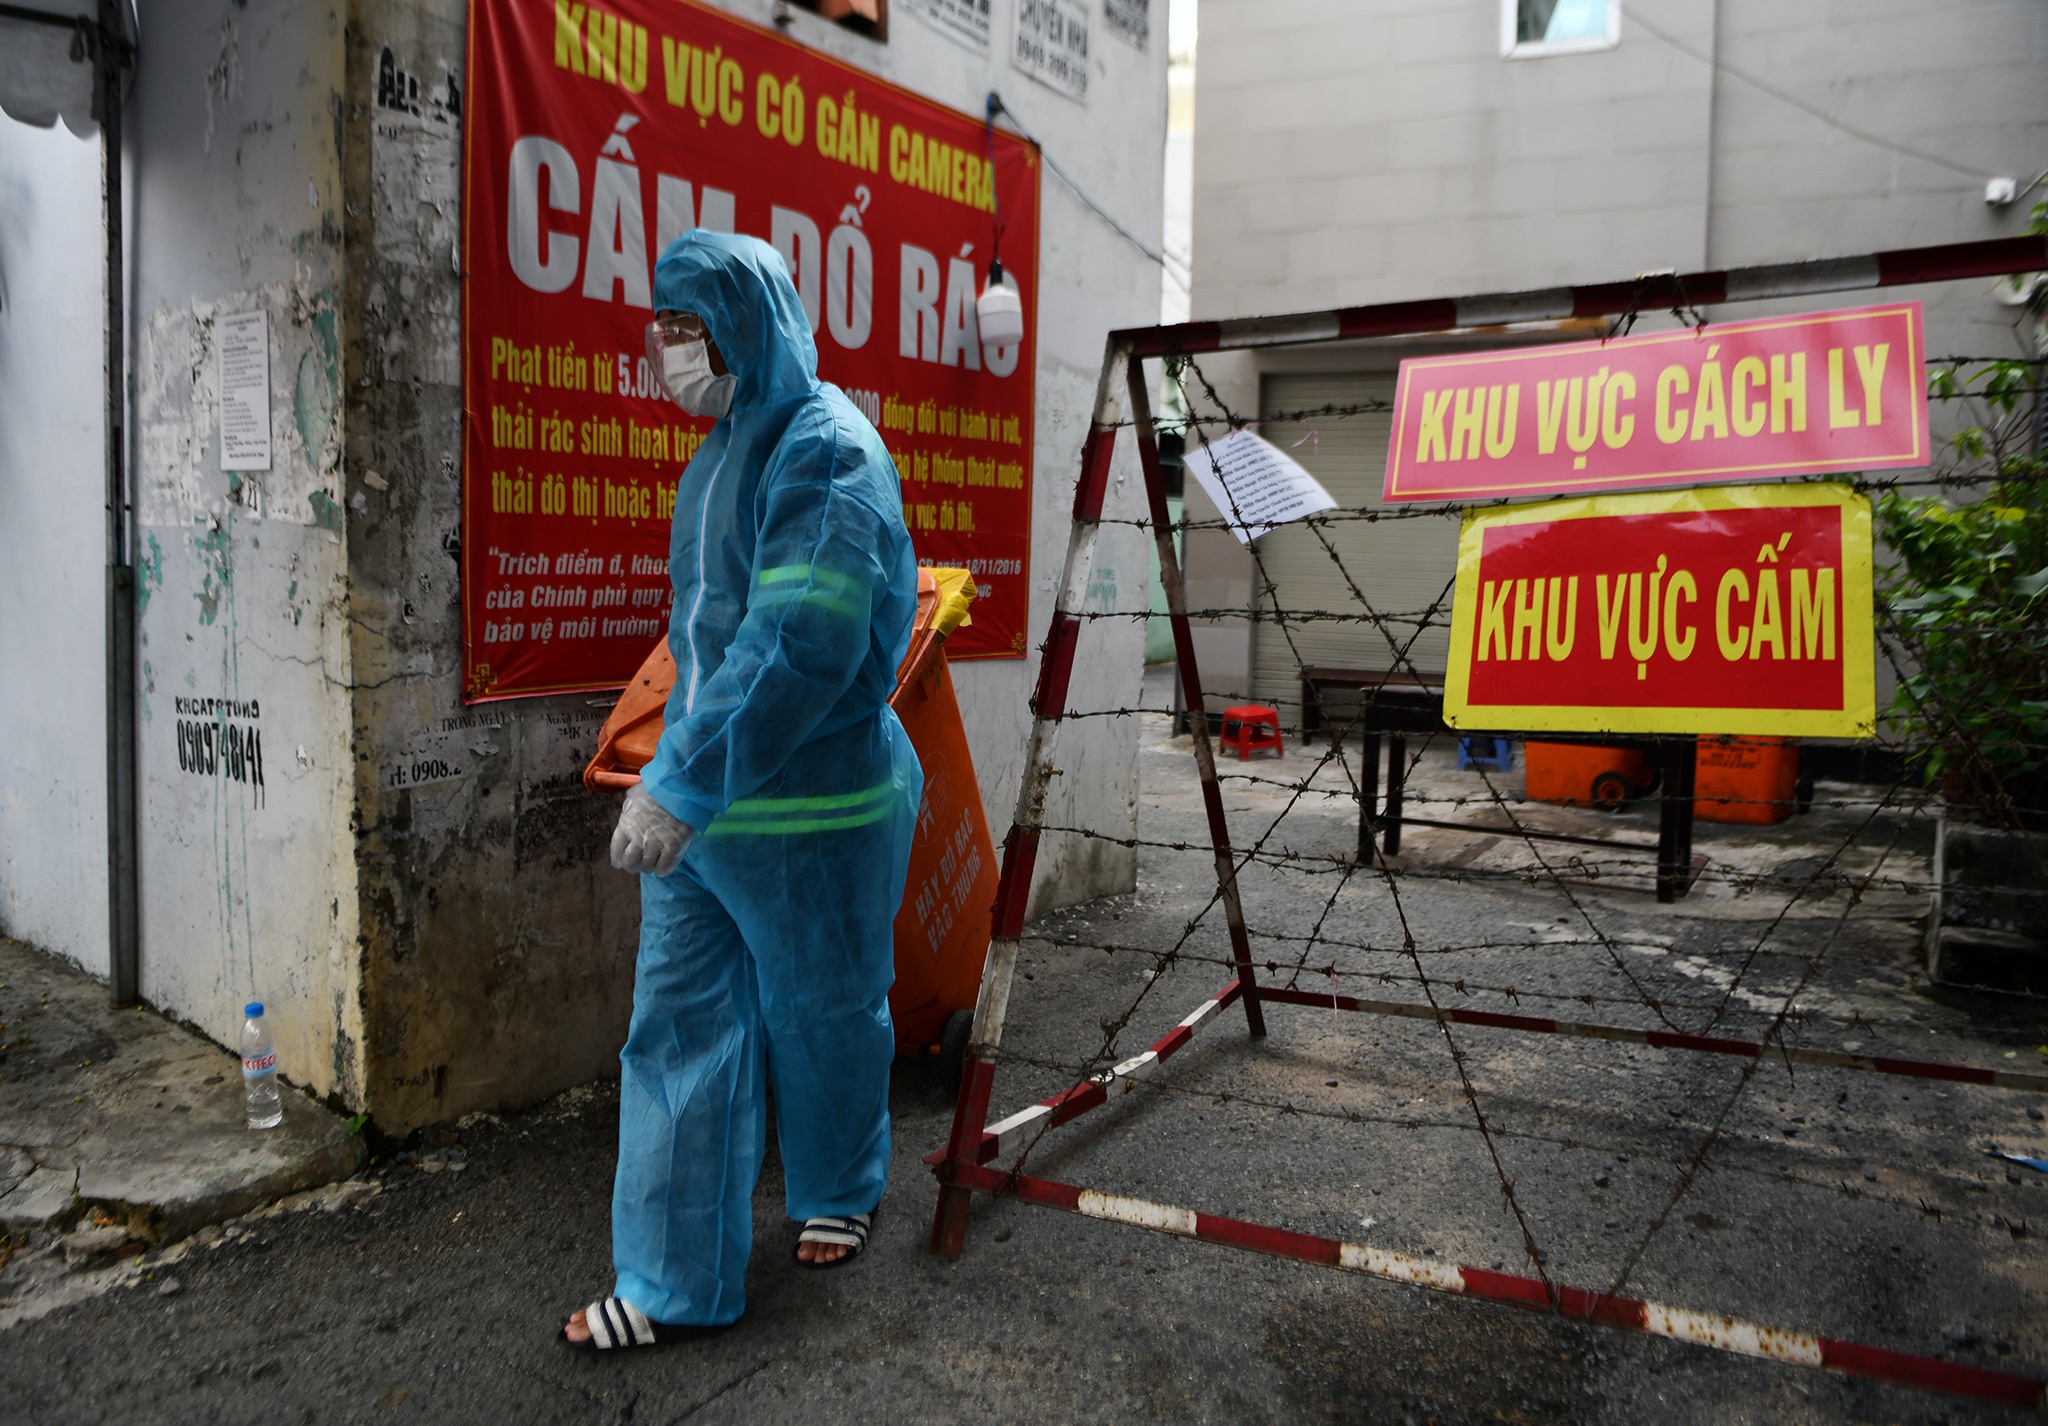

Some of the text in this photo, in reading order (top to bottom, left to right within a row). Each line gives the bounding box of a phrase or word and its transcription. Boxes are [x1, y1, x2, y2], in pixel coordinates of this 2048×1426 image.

[555, 0, 996, 214] KHU VỰC CÓ GẮN CAMERA
[771, 184, 873, 350] ĐỔ
[492, 337, 541, 394] Phạt
[548, 339, 587, 391] tiền
[593, 352, 613, 394] từ
[883, 393, 914, 436] đồng
[940, 406, 957, 437] với
[960, 408, 987, 441] hành
[1416, 343, 1890, 470] KHU VỰC CÁCH LY
[492, 402, 533, 450] thải
[541, 410, 574, 453] rác
[581, 414, 622, 458] sinh
[629, 417, 669, 469] hoạt
[914, 450, 929, 489] hệ
[932, 449, 964, 489] thống
[967, 456, 995, 487] thoát
[998, 459, 1024, 490] nước
[492, 466, 533, 515] thải
[541, 473, 566, 516] đô
[572, 476, 598, 526] thị
[605, 477, 650, 527] hoặc
[916, 504, 937, 537] vực
[940, 500, 954, 531] đô
[957, 502, 975, 538] thị.
[485, 583, 525, 609] của
[531, 585, 587, 608] Chính
[592, 582, 626, 609] phủ
[632, 588, 664, 608] quy
[555, 549, 603, 575] điểm
[609, 554, 625, 577] đ,
[1477, 532, 1837, 680] KHU VỰC CẤM
[484, 616, 525, 643] bảo
[531, 617, 553, 644] vệ
[559, 616, 597, 639] môi
[914, 807, 974, 926] HÃY BỎ RÁC
[927, 845, 981, 954] VÀO THÙNG
